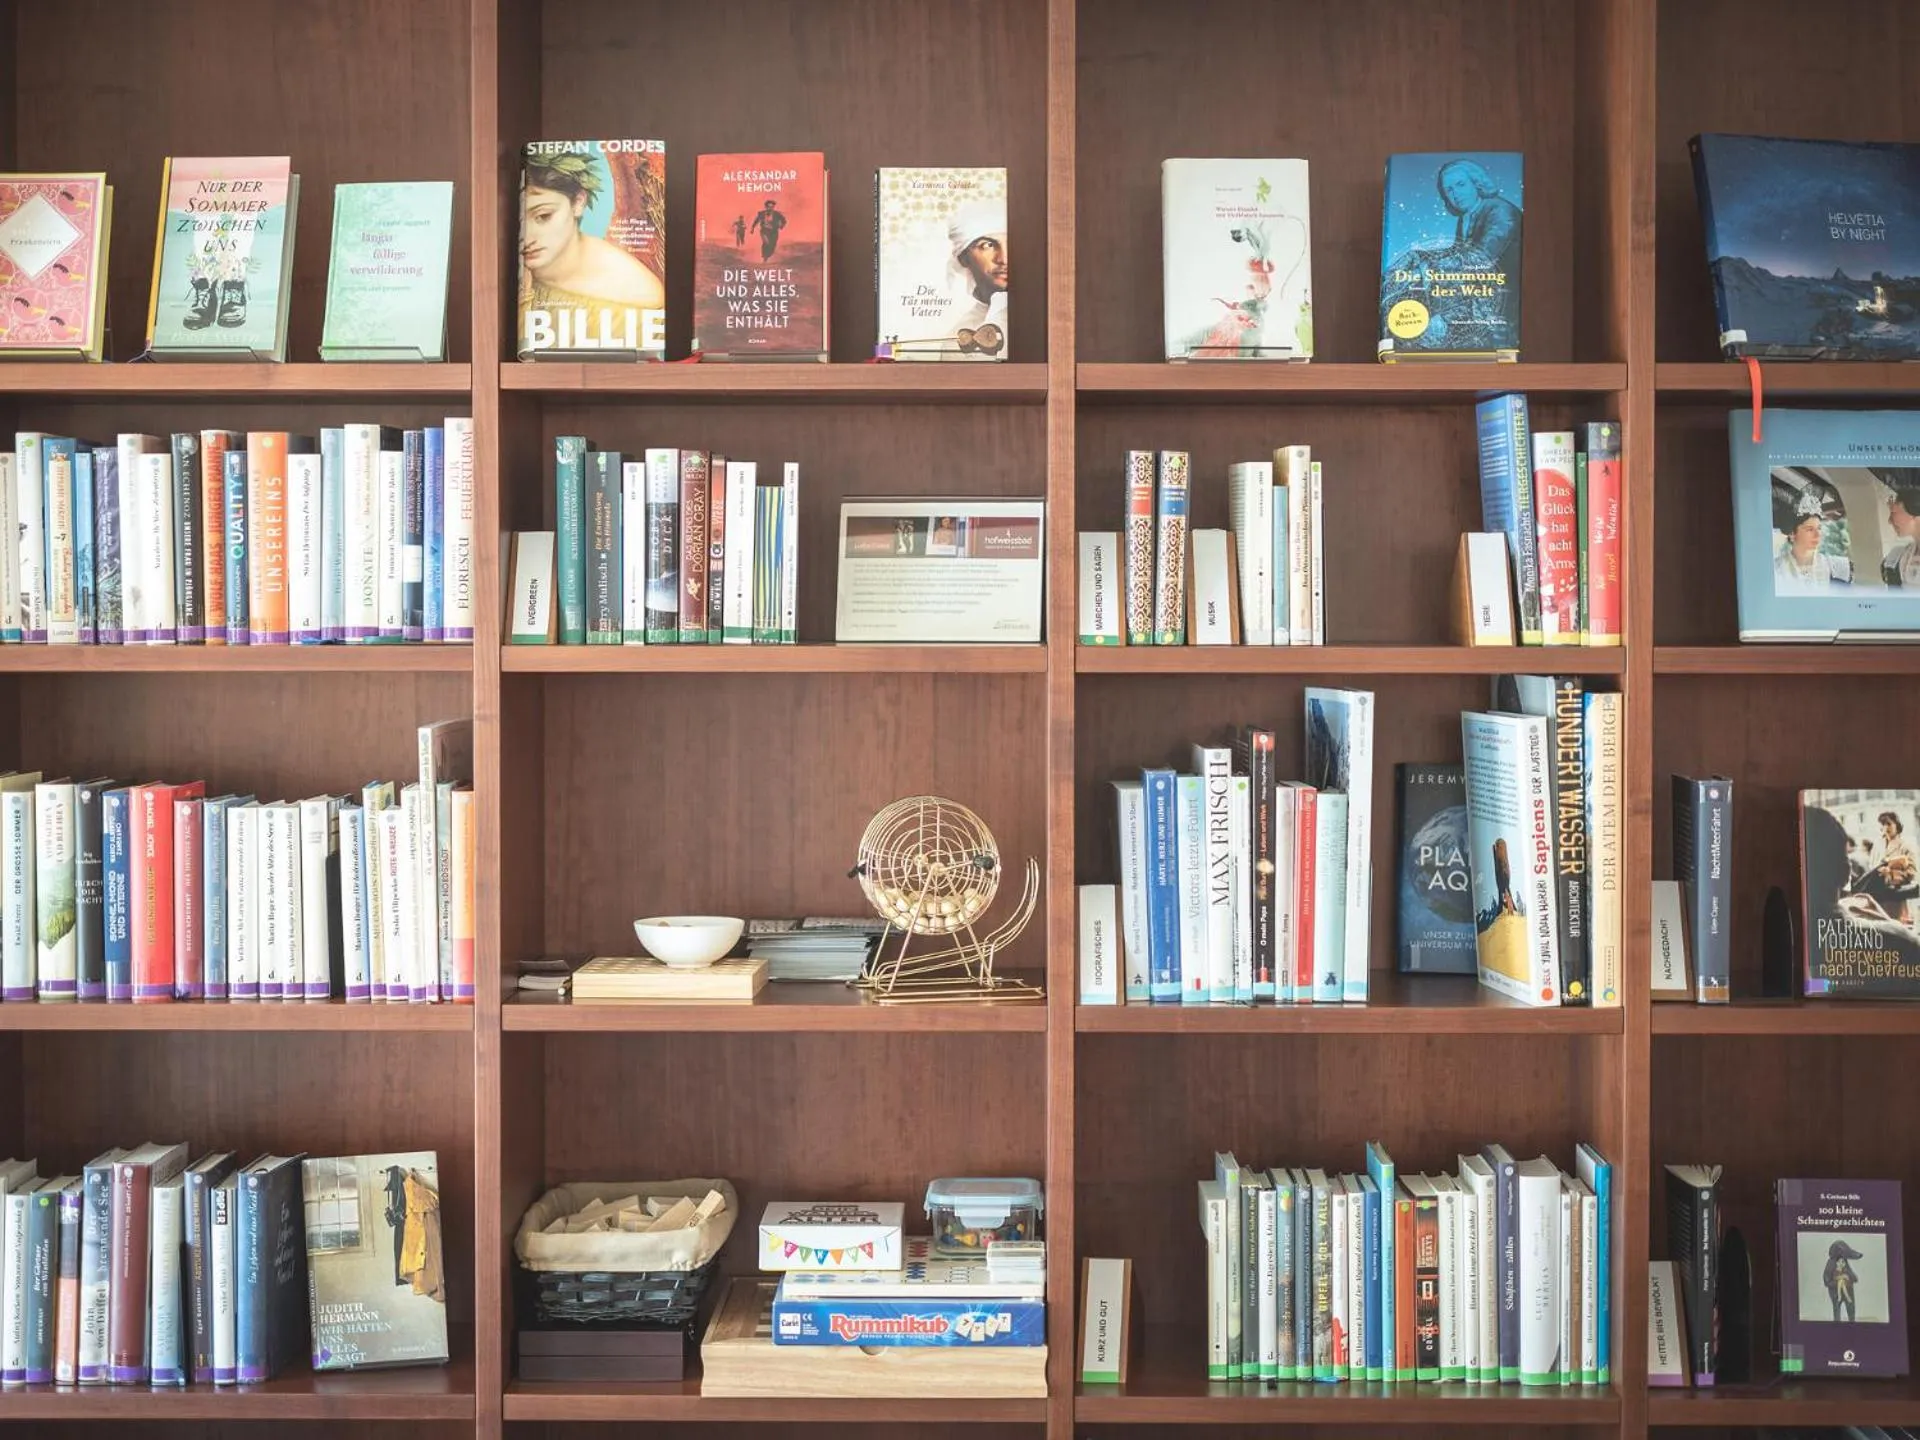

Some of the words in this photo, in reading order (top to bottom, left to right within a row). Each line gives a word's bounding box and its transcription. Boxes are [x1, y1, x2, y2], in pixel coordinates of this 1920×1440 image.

[527, 141, 589, 155] STEFAN
[596, 140, 665, 153] CORDES
[197, 181, 227, 193] NUR
[231, 181, 263, 192] DER
[723, 170, 797, 183] ALEKSANDAR
[738, 182, 782, 193] HEMON
[185, 198, 268, 212] SOMMER
[177, 219, 267, 232] ZWISCHEN
[1828, 212, 1885, 226] HELVETIA
[204, 239, 238, 252] UNS
[1831, 228, 1847, 239] BY
[1849, 228, 1886, 240] NIGHT
[724, 270, 748, 282] DIE
[754, 269, 793, 281] WELT
[1395, 270, 1421, 282] Die
[1425, 269, 1506, 285] Stimmung
[717, 285, 747, 298] UND
[753, 284, 800, 298] ALLES,
[917, 285, 936, 296] Die
[920, 297, 953, 307] meines
[1431, 285, 1457, 297] der
[1461, 286, 1494, 297] Welt
[729, 301, 762, 313] WAS
[765, 300, 788, 312] SIE
[911, 307, 942, 318] Vaters
[525, 308, 665, 350] BILLIE
[726, 314, 790, 329] ENTHÄLT
[1849, 443, 1883, 452] UNSER
[206, 446, 221, 483] MANN
[1514, 412, 1531, 510] TIERGESCHICHTEN
[460, 431, 473, 520] FEUERTURM
[1548, 485, 1570, 497] Das
[207, 487, 222, 534] JUNGER
[693, 487, 704, 523] GRAY
[1542, 502, 1575, 515] Glück
[228, 478, 244, 560] QUALITY
[266, 477, 282, 592] UNSEREINS
[1521, 511, 1534, 556] Fasnachts
[208, 543, 222, 575] HAAS
[693, 525, 705, 573] DORIAN
[1094, 545, 1103, 572] SAGEN
[458, 537, 469, 610] FLORESCU
[597, 562, 608, 605] Mulisch
[1095, 573, 1103, 590] UND
[1523, 557, 1535, 592] Monika
[209, 580, 223, 613] WOLF
[527, 578, 539, 626] EVERGREEN
[1207, 601, 1216, 626] MUSIK
[1483, 605, 1492, 628] TIERE
[1602, 702, 1616, 758] BERGE
[1529, 734, 1540, 773] AUFSTIEG
[1532, 776, 1542, 795] DER
[1557, 690, 1586, 876] HUNDERTWASSER
[1602, 763, 1616, 797] DER
[1156, 796, 1165, 823] HUMOR
[1186, 798, 1200, 833] Fahrt
[1209, 762, 1229, 845] FRISCH
[1531, 799, 1548, 876] Sapiens
[1602, 803, 1616, 852] ATEM
[1187, 835, 1201, 870] letzte
[1710, 808, 1722, 879] NachtMeerFahrt
[109, 870, 117, 903] MOND
[1211, 852, 1230, 906] MAX
[1602, 863, 1616, 891] DER
[117, 873, 125, 914] STERNE
[1188, 872, 1202, 919] Victors
[1538, 879, 1550, 911] HARARI
[1260, 905, 1269, 923] Papa
[1568, 880, 1581, 938] ARCHITEKTUR
[117, 917, 125, 938] UND
[1260, 923, 1268, 940] mein
[1540, 914, 1551, 938] NOAH
[1818, 918, 1879, 935] PATRICK
[1094, 919, 1103, 986] BIOGRAFISCHES
[1541, 940, 1552, 965] YUVAL
[1660, 918, 1672, 980] NACHGEDACHT
[1818, 933, 1884, 950] MODIANO
[1819, 961, 1853, 977] nach
[1825, 948, 1900, 965] Unterwegs
[98, 1185, 109, 1206] See
[1797, 1216, 1886, 1228] Schauergeschichten
[1819, 1207, 1834, 1215] 100
[1836, 1205, 1864, 1215] kleine
[88, 1214, 96, 1235] Der
[98, 1211, 109, 1272] brennende
[1505, 1270, 1516, 1311] Schäfchen
[96, 1288, 107, 1324] Düffel
[319, 1302, 364, 1314] JUDITH
[320, 1310, 379, 1324] HERMANN
[1099, 1299, 1108, 1318] GUT
[85, 1307, 94, 1336] John
[320, 1325, 344, 1336] WIR
[346, 1320, 392, 1334] HÄTTEN
[829, 1313, 949, 1341] Rummikub
[1098, 1319, 1107, 1338] UND
[1655, 1319, 1665, 1334] BIS
[97, 1328, 106, 1350] von
[1097, 1339, 1107, 1363] KURZ
[1657, 1335, 1668, 1366] HEITER
